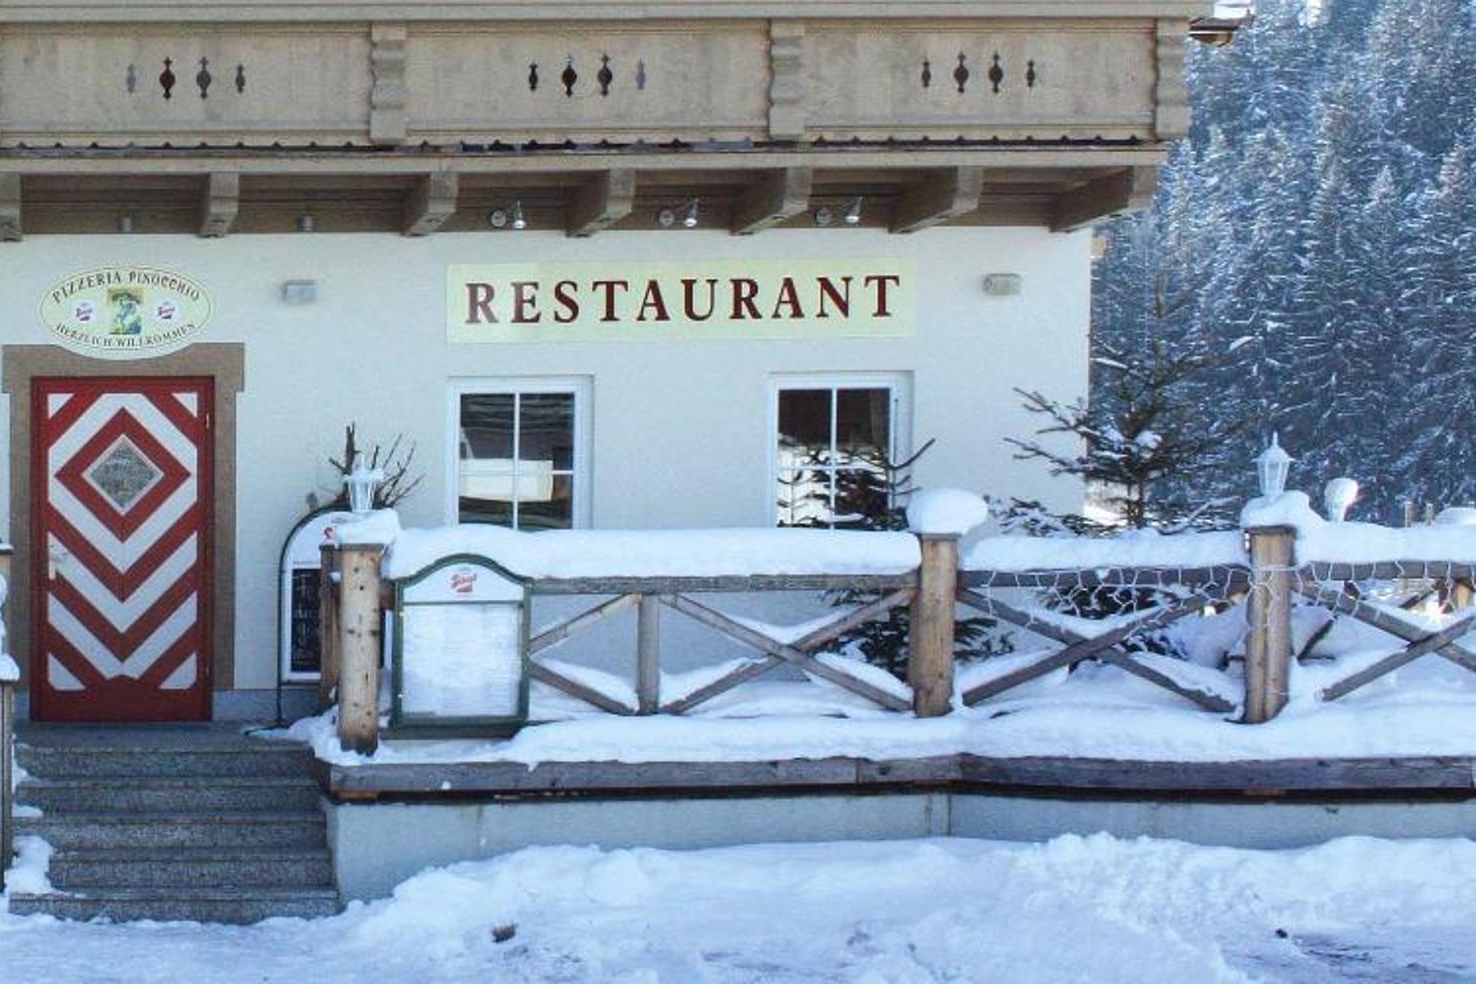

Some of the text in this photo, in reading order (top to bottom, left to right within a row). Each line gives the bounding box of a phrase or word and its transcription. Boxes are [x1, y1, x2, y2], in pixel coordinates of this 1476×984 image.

[52, 270, 201, 304] PIZZERIA PINOCCHIO
[464, 274, 901, 324] RESTAURANT
